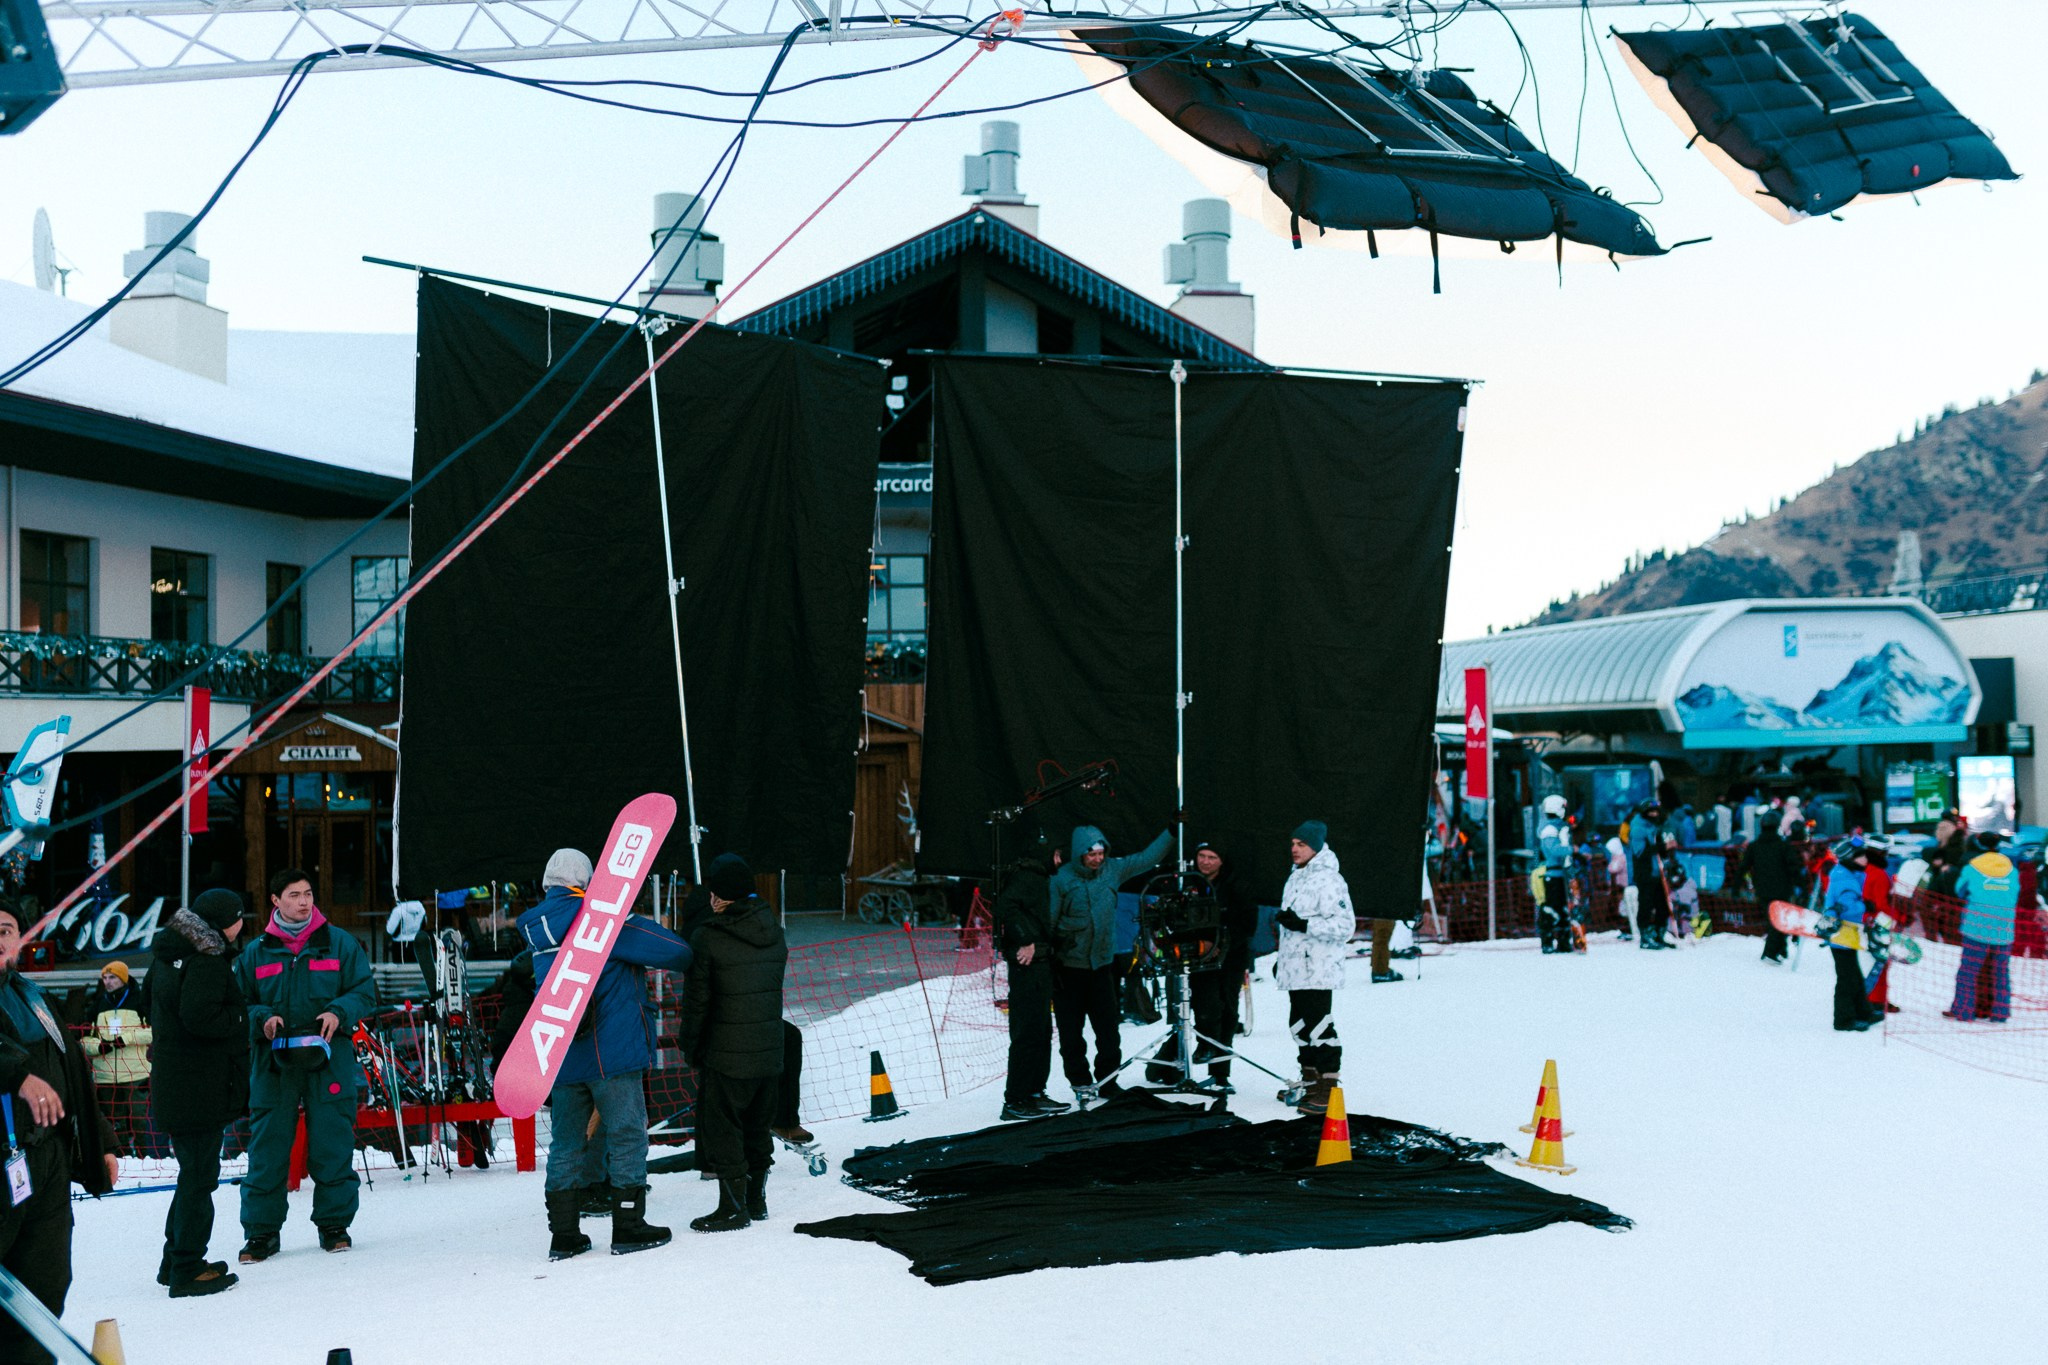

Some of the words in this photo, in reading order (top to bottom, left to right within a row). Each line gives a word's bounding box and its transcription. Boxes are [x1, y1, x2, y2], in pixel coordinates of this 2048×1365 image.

[288, 748, 351, 758] CHALET
[448, 940, 459, 997] HEAD
[530, 882, 631, 1077] ALTEL
[616, 833, 643, 868] 5G
